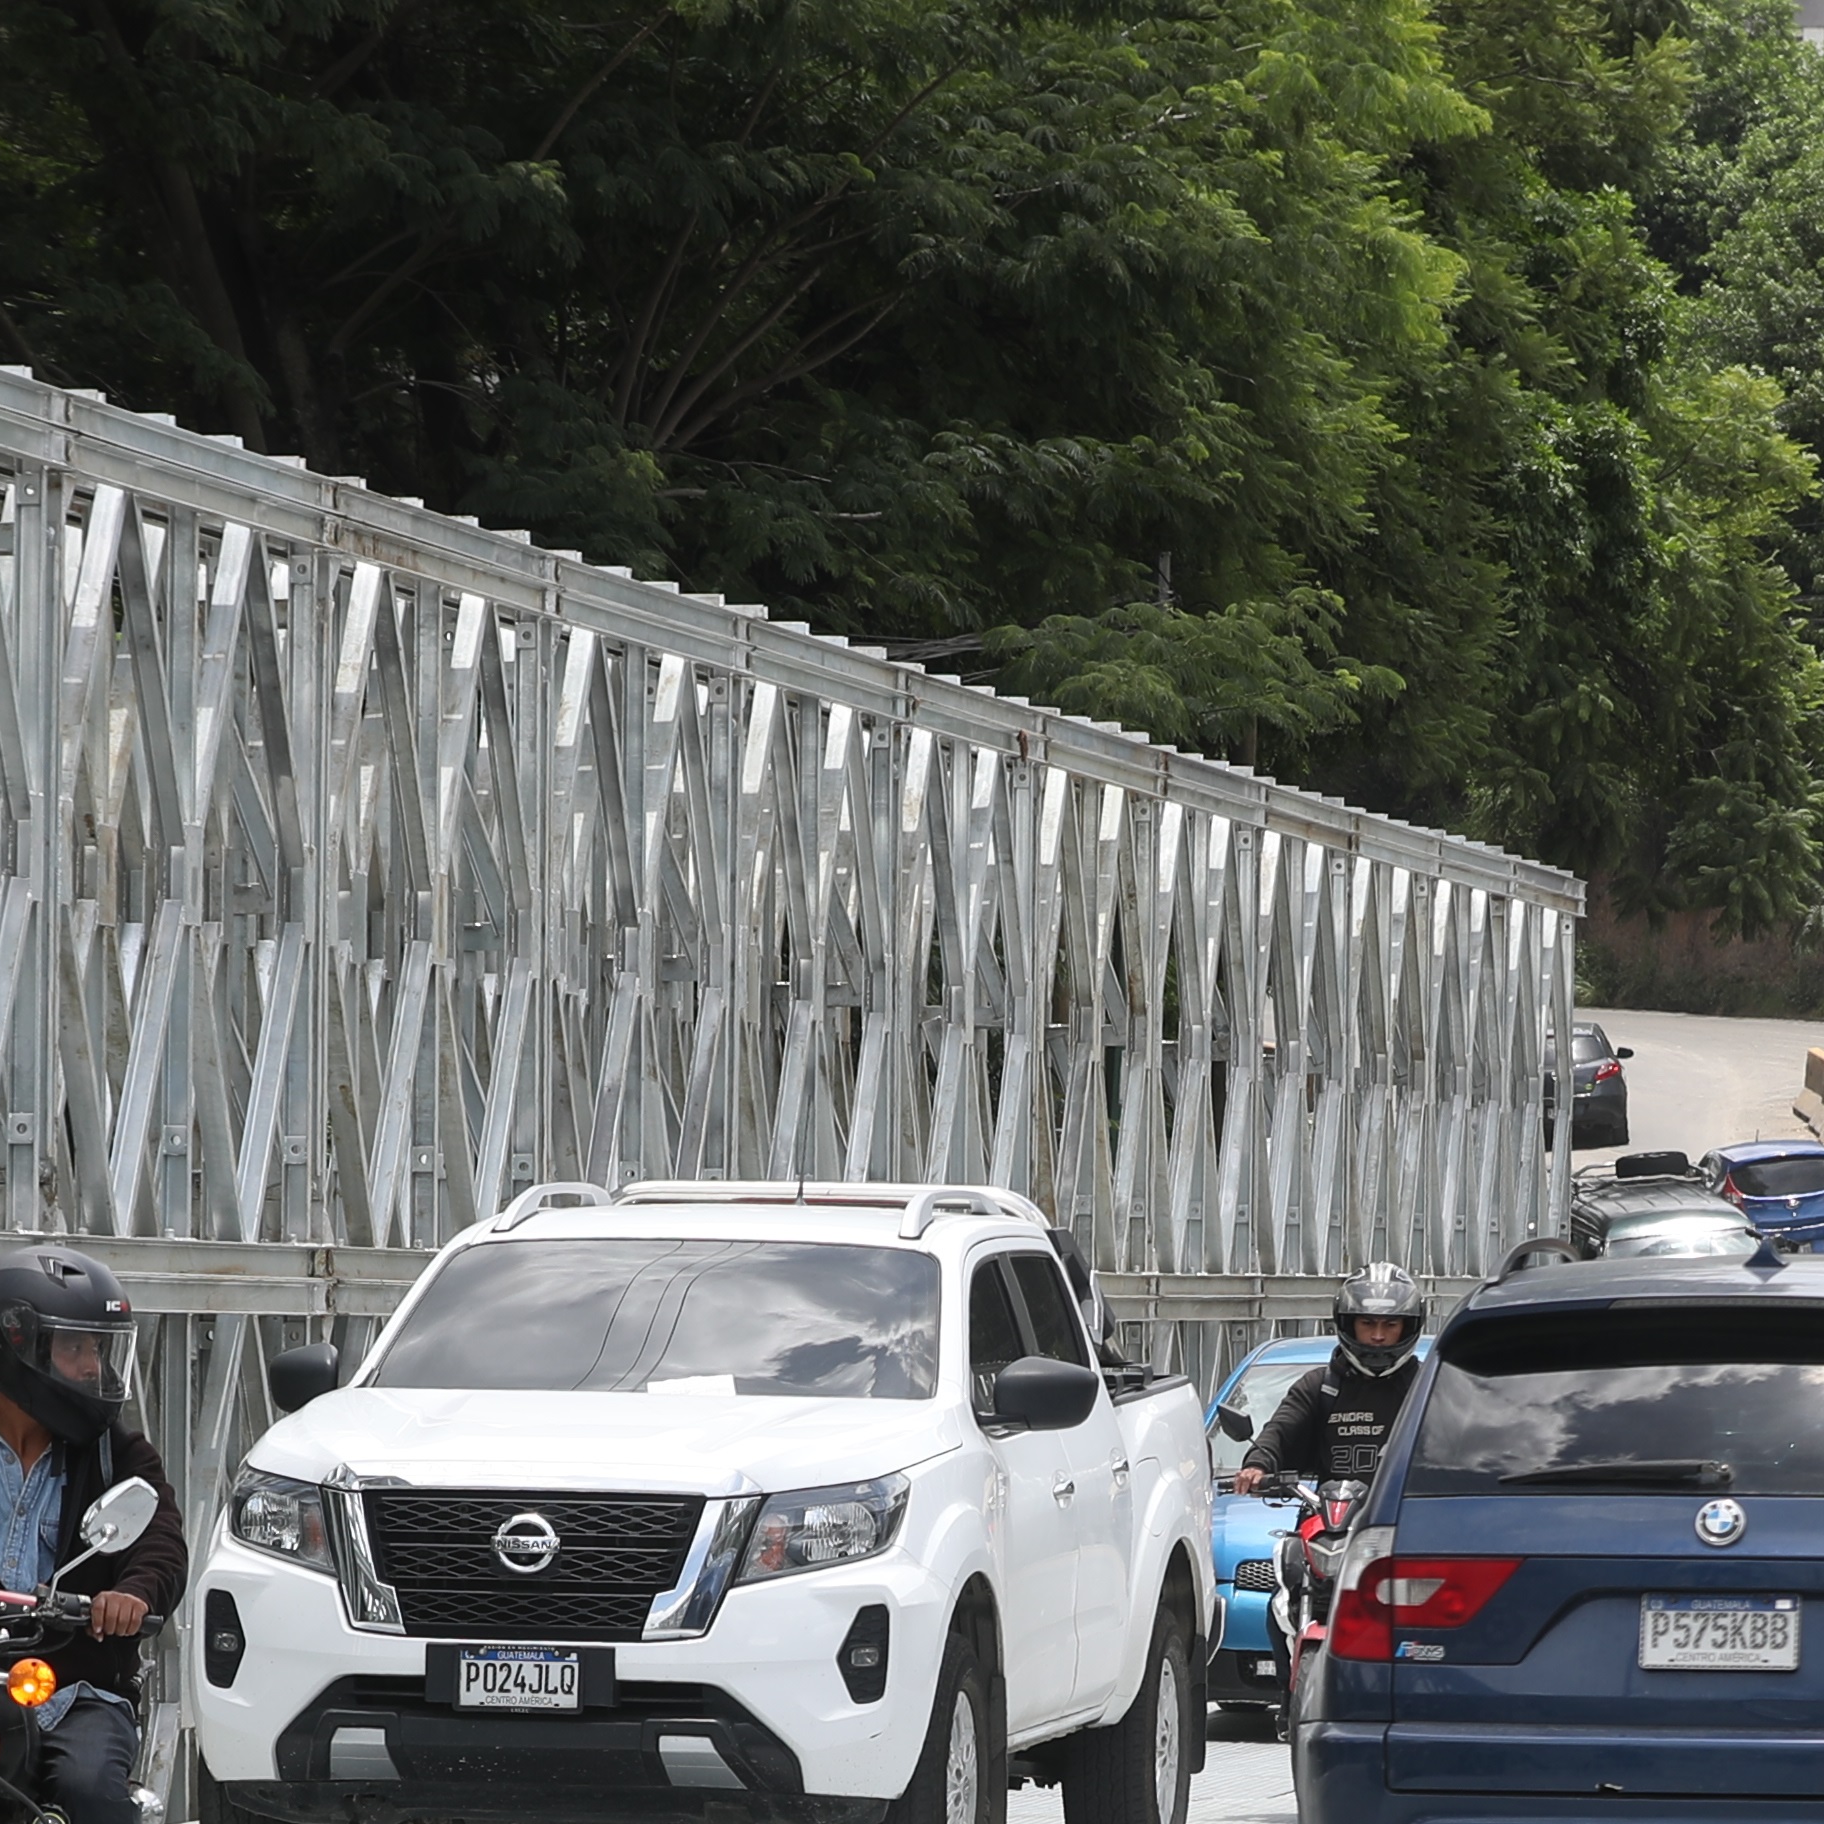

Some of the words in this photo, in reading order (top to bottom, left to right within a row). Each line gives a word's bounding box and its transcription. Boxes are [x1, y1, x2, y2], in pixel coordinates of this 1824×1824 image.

[1337, 1425, 1371, 1436] CLASS
[1371, 1425, 1385, 1436] OF
[496, 1539, 552, 1550] NISSAN
[1691, 1599, 1751, 1610] GUATEMALA
[1651, 1611, 1789, 1650] P575KBB
[497, 1650, 545, 1660] GUATEMALA
[1676, 1652, 1716, 1663] CENTRO
[465, 1661, 576, 1695] P024JLQ
[485, 1695, 517, 1705] CENTRO
[518, 1694, 554, 1706] AMÉRICA
